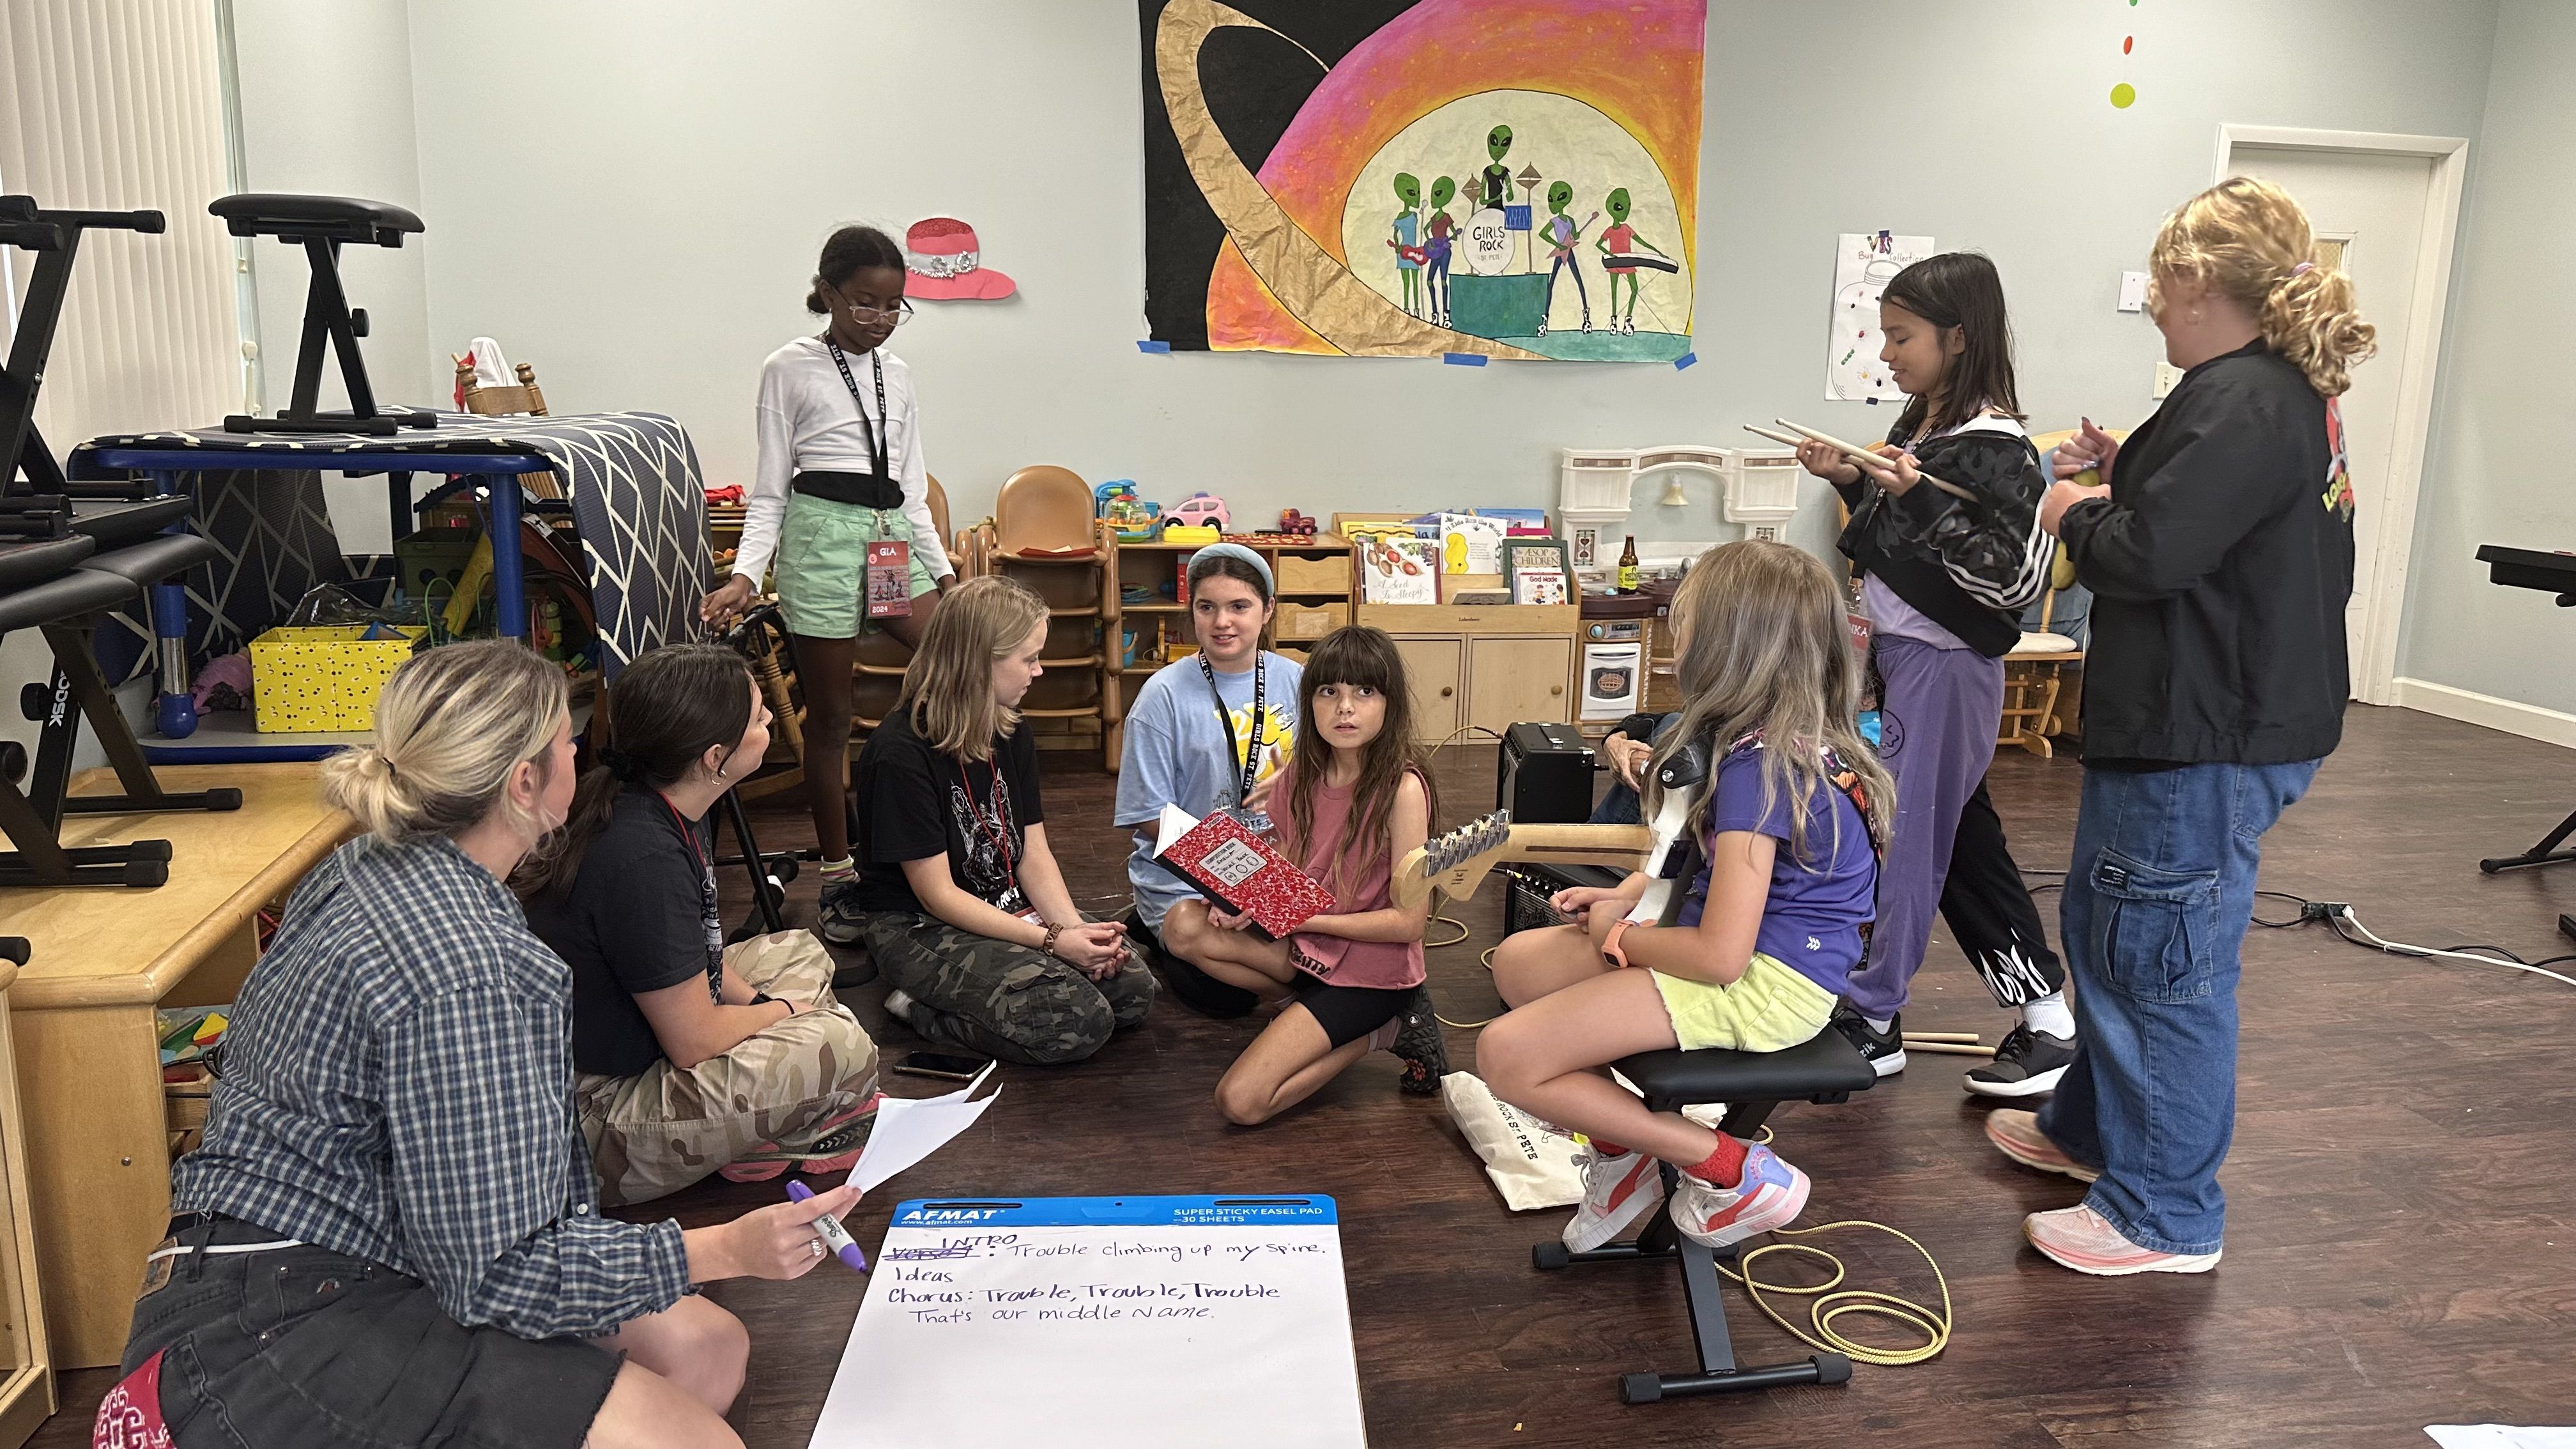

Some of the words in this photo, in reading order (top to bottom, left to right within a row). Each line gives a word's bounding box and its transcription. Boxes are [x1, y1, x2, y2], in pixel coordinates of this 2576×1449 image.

[1473, 226, 1505, 240] GIRLS
[1480, 239, 1503, 252] ROCK
[1859, 250, 1873, 262] Bug
[880, 548, 896, 556] GIA
[1515, 556, 1558, 565] CHILDREN
[1244, 773, 1253, 790] PETE
[1496, 1103, 1515, 1121] ROCK
[1516, 1134, 1538, 1160] PETE
[901, 1209, 997, 1220] AFMAT
[942, 1234, 1018, 1248] INTRO
[1007, 1243, 1088, 1257] Trouble
[1190, 1245, 1212, 1257] up
[1226, 1245, 1260, 1262] my
[895, 1267, 954, 1284] Ideas
[888, 1287, 974, 1303] Chorus:
[979, 1284, 1077, 1302] Trouble,
[1080, 1284, 1186, 1300] Trouble,
[1181, 1283, 1281, 1298] Trouble
[908, 1308, 972, 1324] That's
[992, 1310, 1028, 1320] our
[1039, 1304, 1121, 1320] middle
